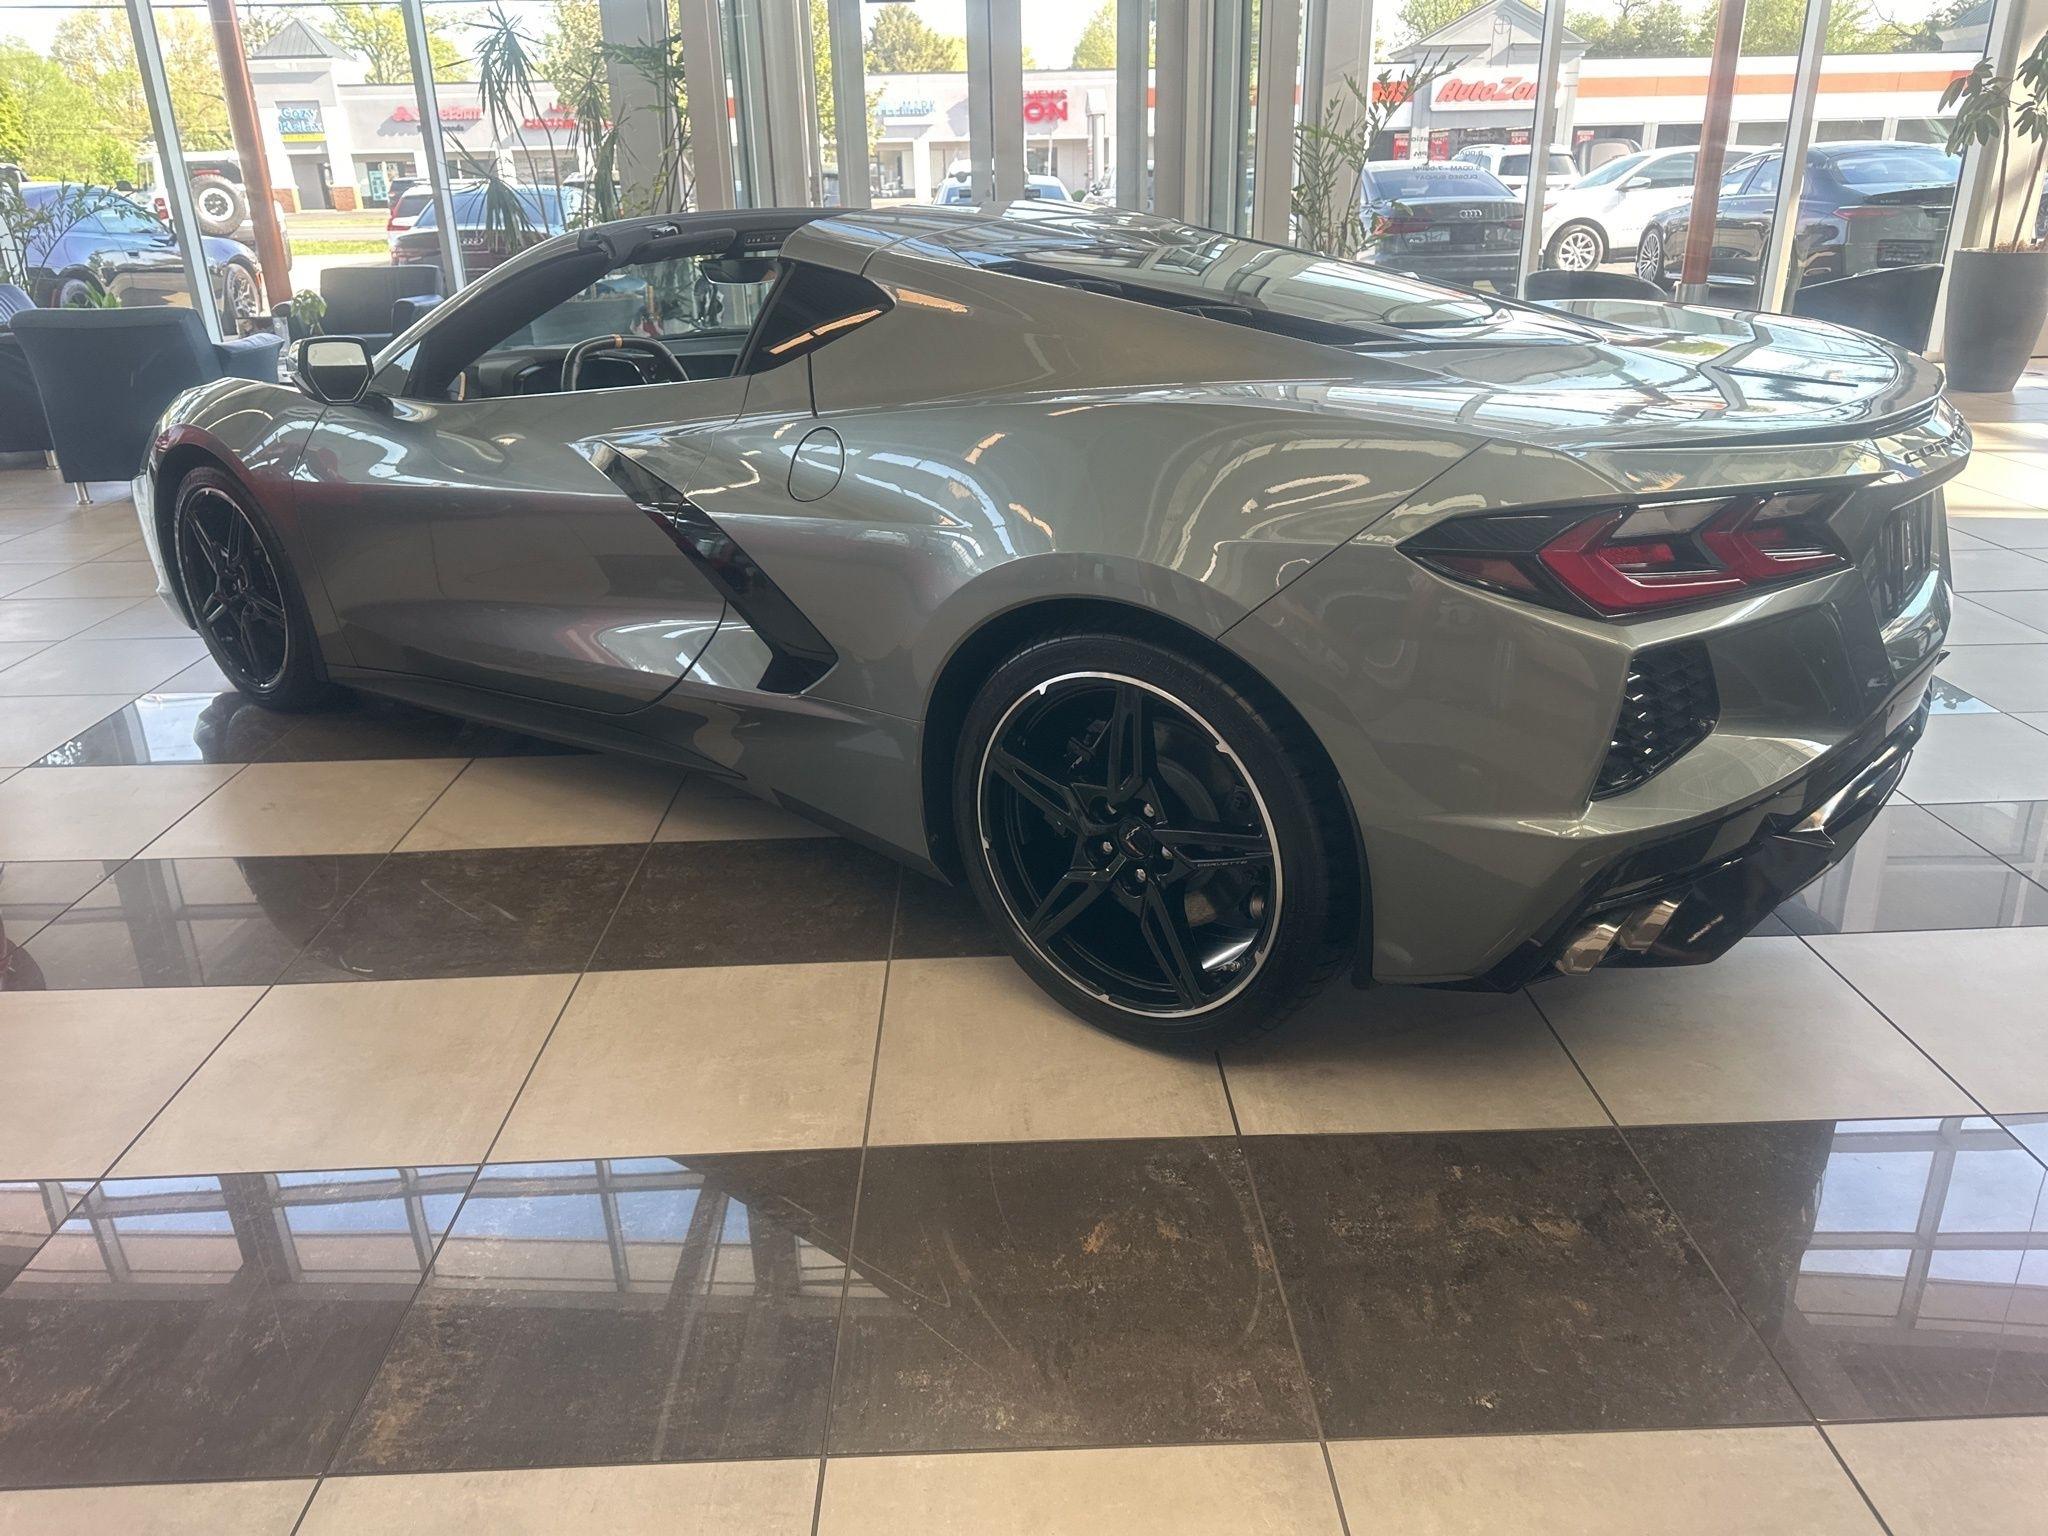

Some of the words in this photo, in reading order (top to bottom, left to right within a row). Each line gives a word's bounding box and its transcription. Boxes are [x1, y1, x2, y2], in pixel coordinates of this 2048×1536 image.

[1437, 77, 1540, 103] AutoZo
[280, 107, 318, 120] Cozy
[280, 119, 323, 132] Relax
